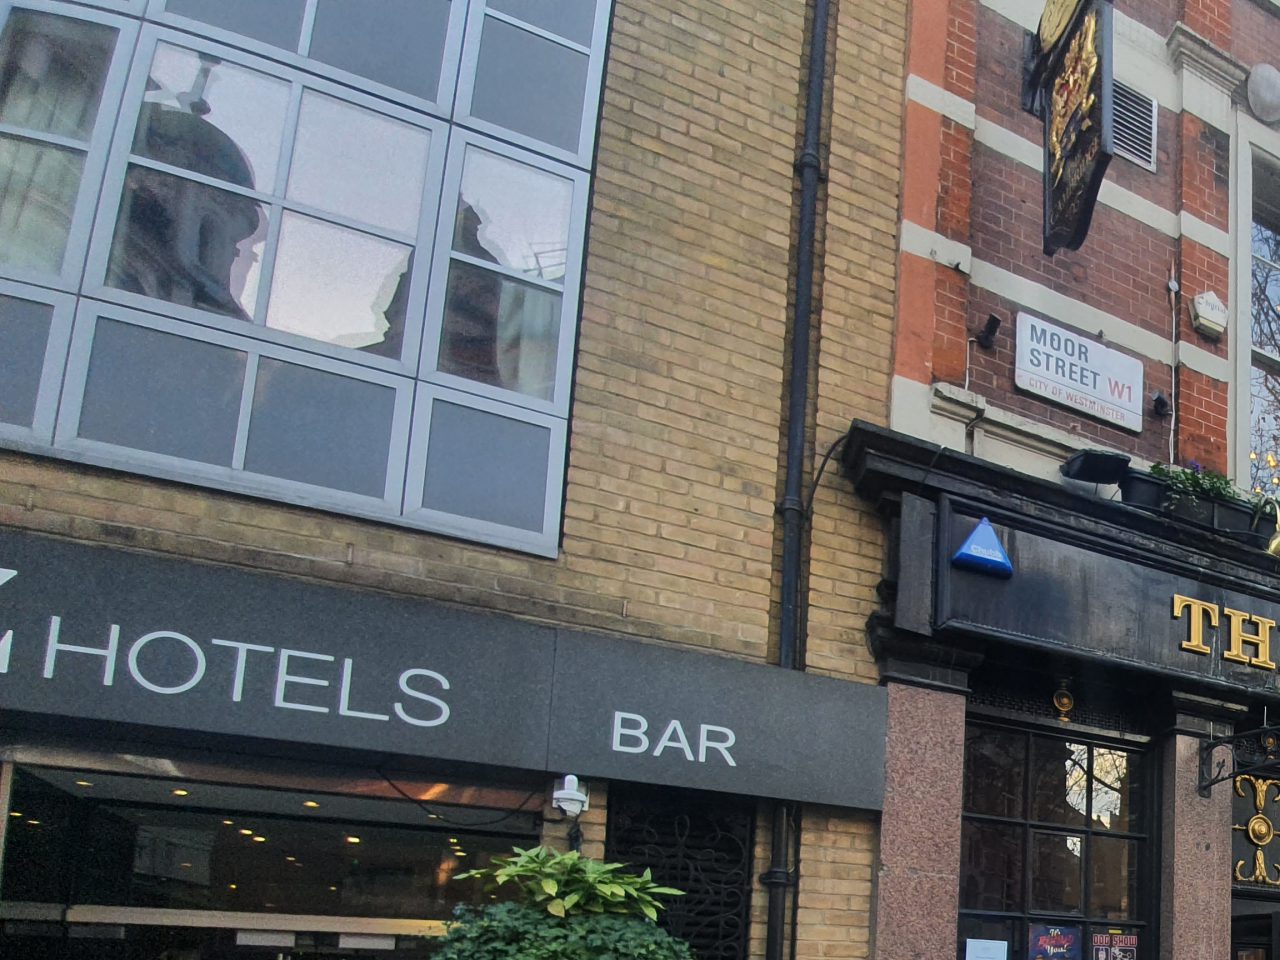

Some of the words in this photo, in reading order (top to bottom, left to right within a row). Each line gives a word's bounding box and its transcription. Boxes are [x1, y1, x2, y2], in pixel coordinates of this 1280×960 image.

[1030, 324, 1089, 363] MOOR
[1029, 348, 1101, 390] STREET
[1108, 377, 1132, 403] W1
[1029, 377, 1049, 392] CITY
[1051, 386, 1062, 396] OF
[1066, 391, 1126, 422] WESTMINSTER
[43, 615, 451, 727] HOTELS
[612, 711, 737, 767] BAR
[1092, 934, 1110, 946] DOG
[1112, 936, 1138, 947] SHOW
